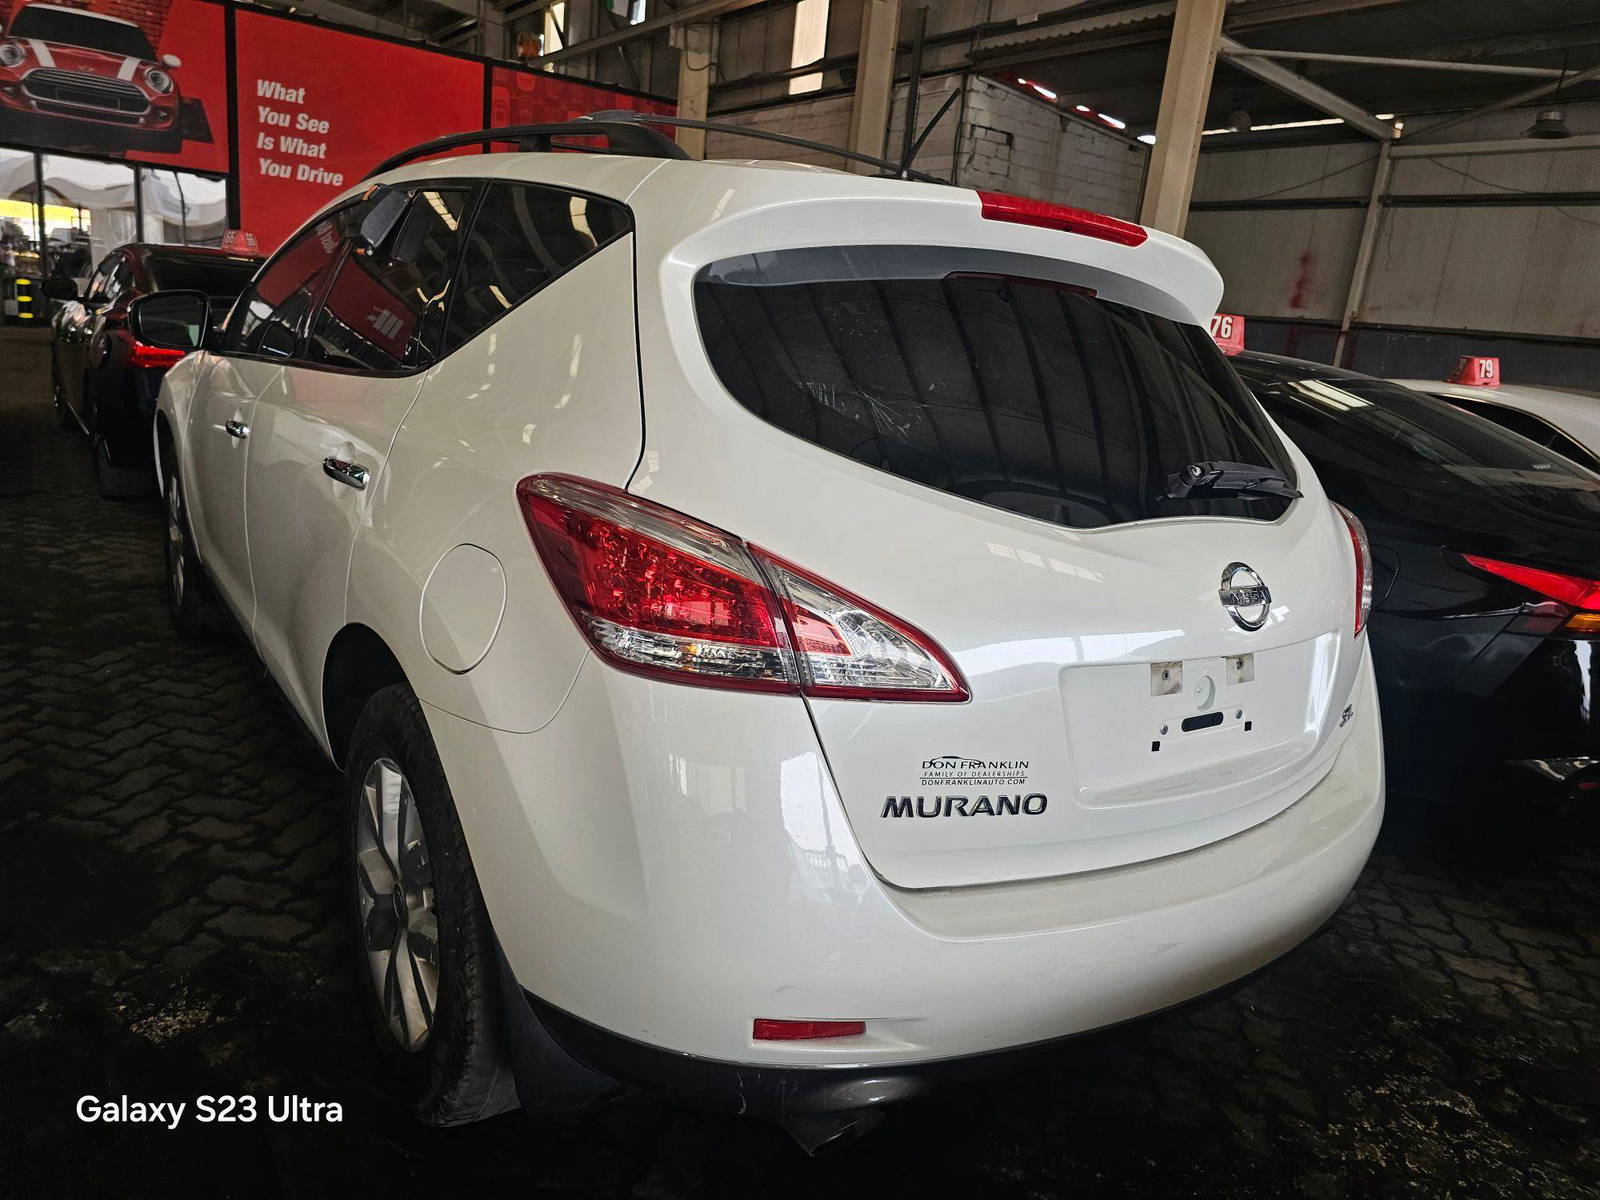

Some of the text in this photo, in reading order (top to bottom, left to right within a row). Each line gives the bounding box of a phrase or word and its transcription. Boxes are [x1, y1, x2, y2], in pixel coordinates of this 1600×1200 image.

[257, 79, 306, 104] What
[258, 105, 330, 134] You See
[257, 131, 327, 159] Is What
[258, 157, 344, 187] You Drive
[1210, 315, 1233, 339] 76
[1479, 359, 1493, 378] 79
[922, 760, 1030, 770] DON FRANKLIN
[957, 770, 968, 778] OF
[921, 778, 1026, 786] DONFRANKLINAUTO.COM
[880, 793, 1048, 818] MURANO
